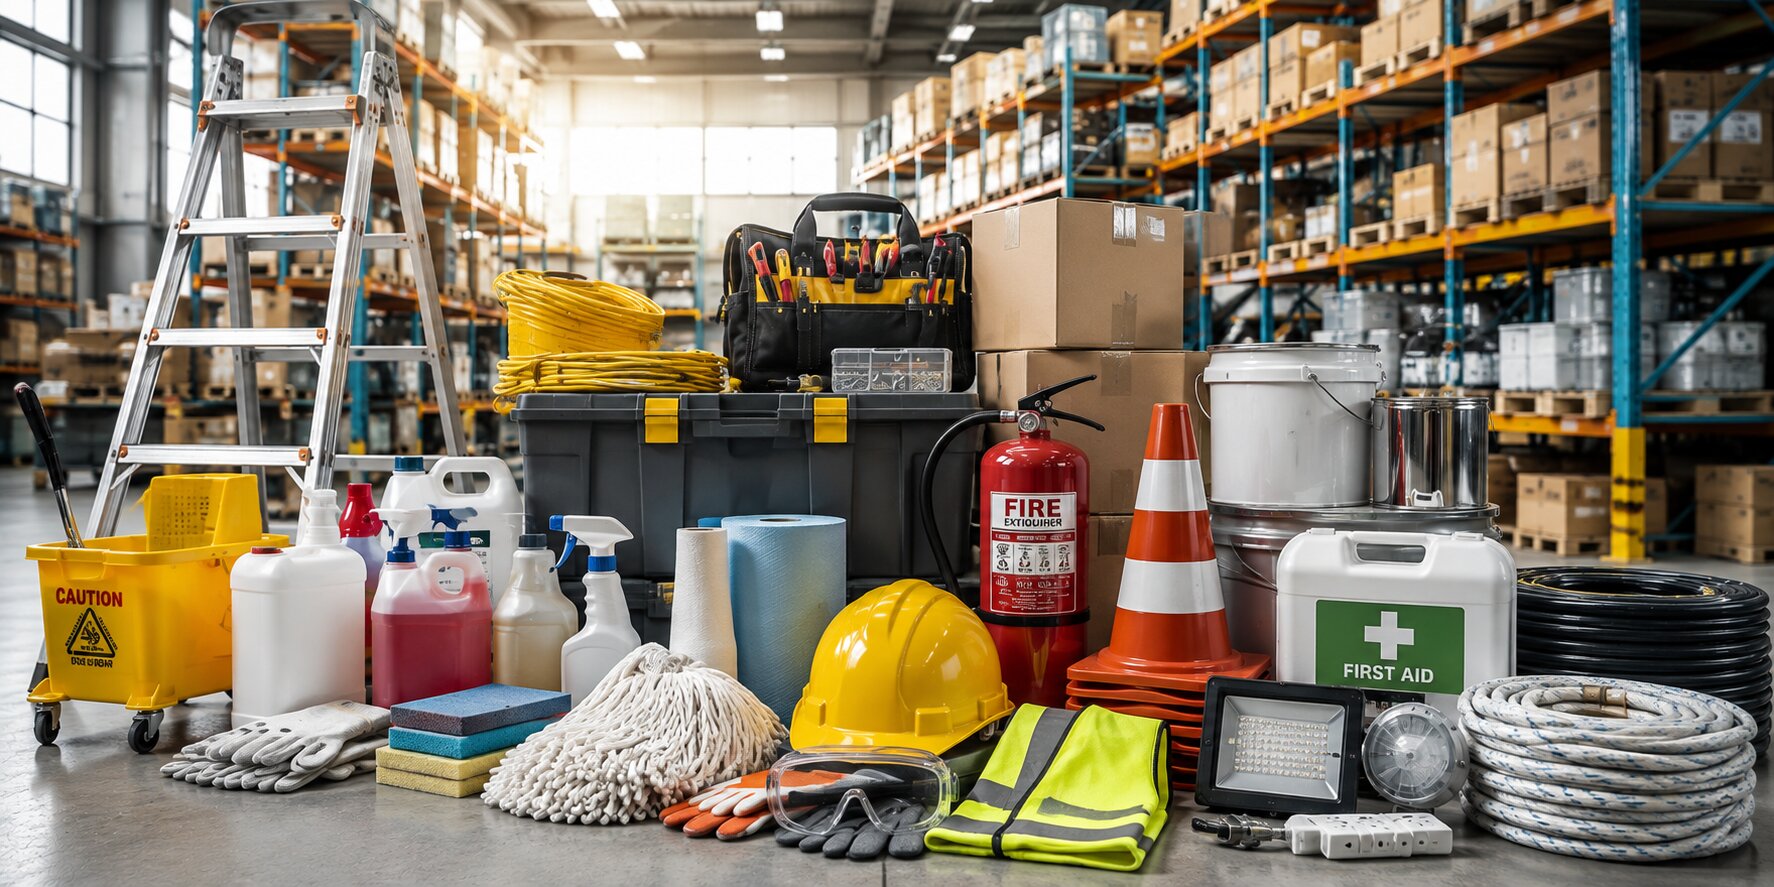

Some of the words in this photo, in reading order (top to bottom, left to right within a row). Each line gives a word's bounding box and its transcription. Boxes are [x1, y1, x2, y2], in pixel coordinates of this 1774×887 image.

[1005, 498, 1061, 517] FIRE
[56, 587, 122, 607] CAUTION
[1343, 663, 1395, 680] FIRST
[1400, 667, 1434, 683] AID
